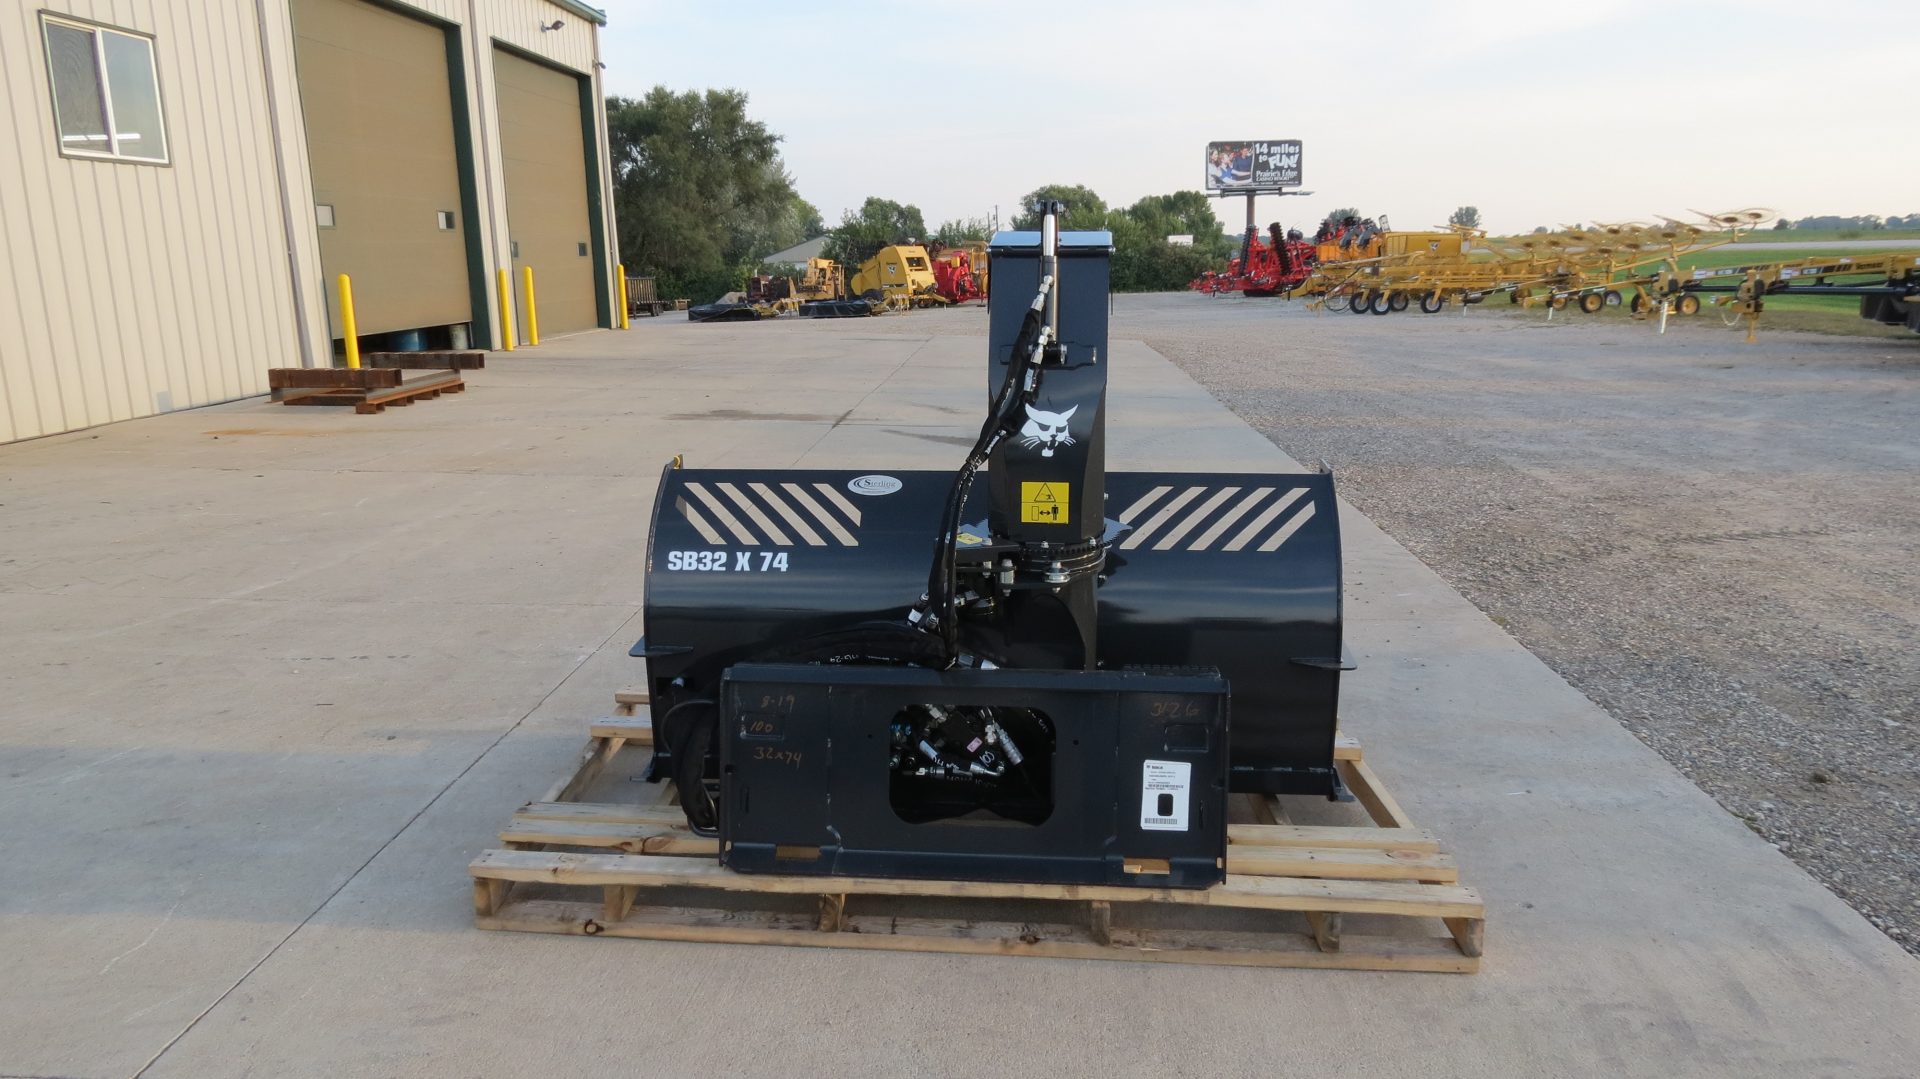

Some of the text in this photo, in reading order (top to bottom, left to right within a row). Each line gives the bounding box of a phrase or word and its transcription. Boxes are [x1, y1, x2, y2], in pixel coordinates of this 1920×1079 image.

[1255, 143, 1299, 154] 14 miles
[1258, 154, 1299, 169] to FUN!
[1282, 169, 1298, 178] Edge
[668, 551, 788, 572] SB32 X 74
[750, 720, 774, 733] 100
